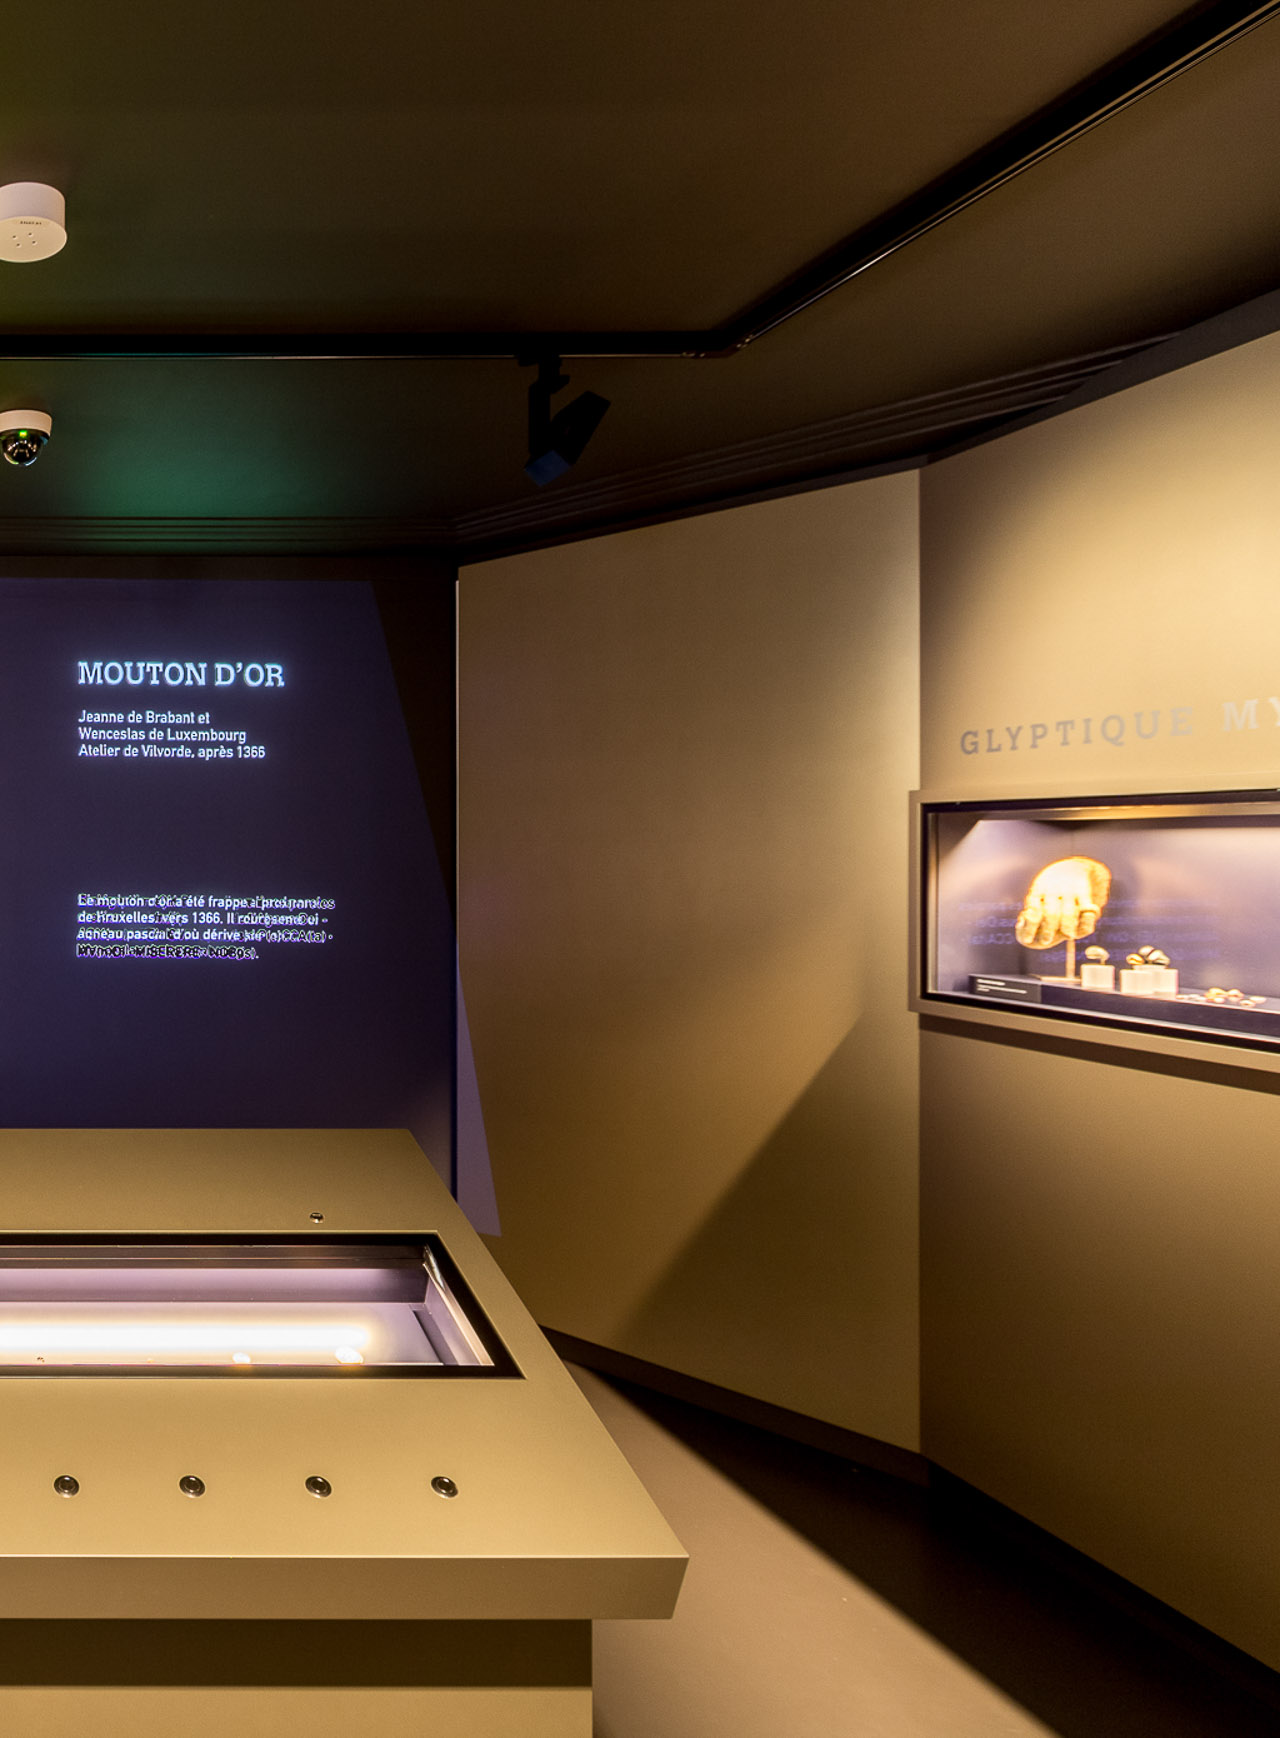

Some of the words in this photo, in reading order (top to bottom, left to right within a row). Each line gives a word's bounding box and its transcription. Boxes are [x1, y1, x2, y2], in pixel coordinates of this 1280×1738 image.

[77, 660, 208, 687] MOUTON
[213, 662, 286, 688] D'OR
[77, 710, 125, 724] Jeanne
[127, 710, 143, 724] de
[145, 711, 196, 725] Brabant
[198, 712, 210, 725] et
[78, 727, 146, 741] Wenceslas
[149, 728, 164, 741] de
[167, 728, 247, 745] Luxembourg
[959, 706, 1194, 756] GLYPTIQUE
[78, 744, 121, 757] Atelier
[124, 745, 139, 758] de
[141, 744, 195, 759] Vilvorde,
[198, 745, 234, 761] après
[237, 746, 266, 759] 1366
[192, 912, 224, 925] 1366.
